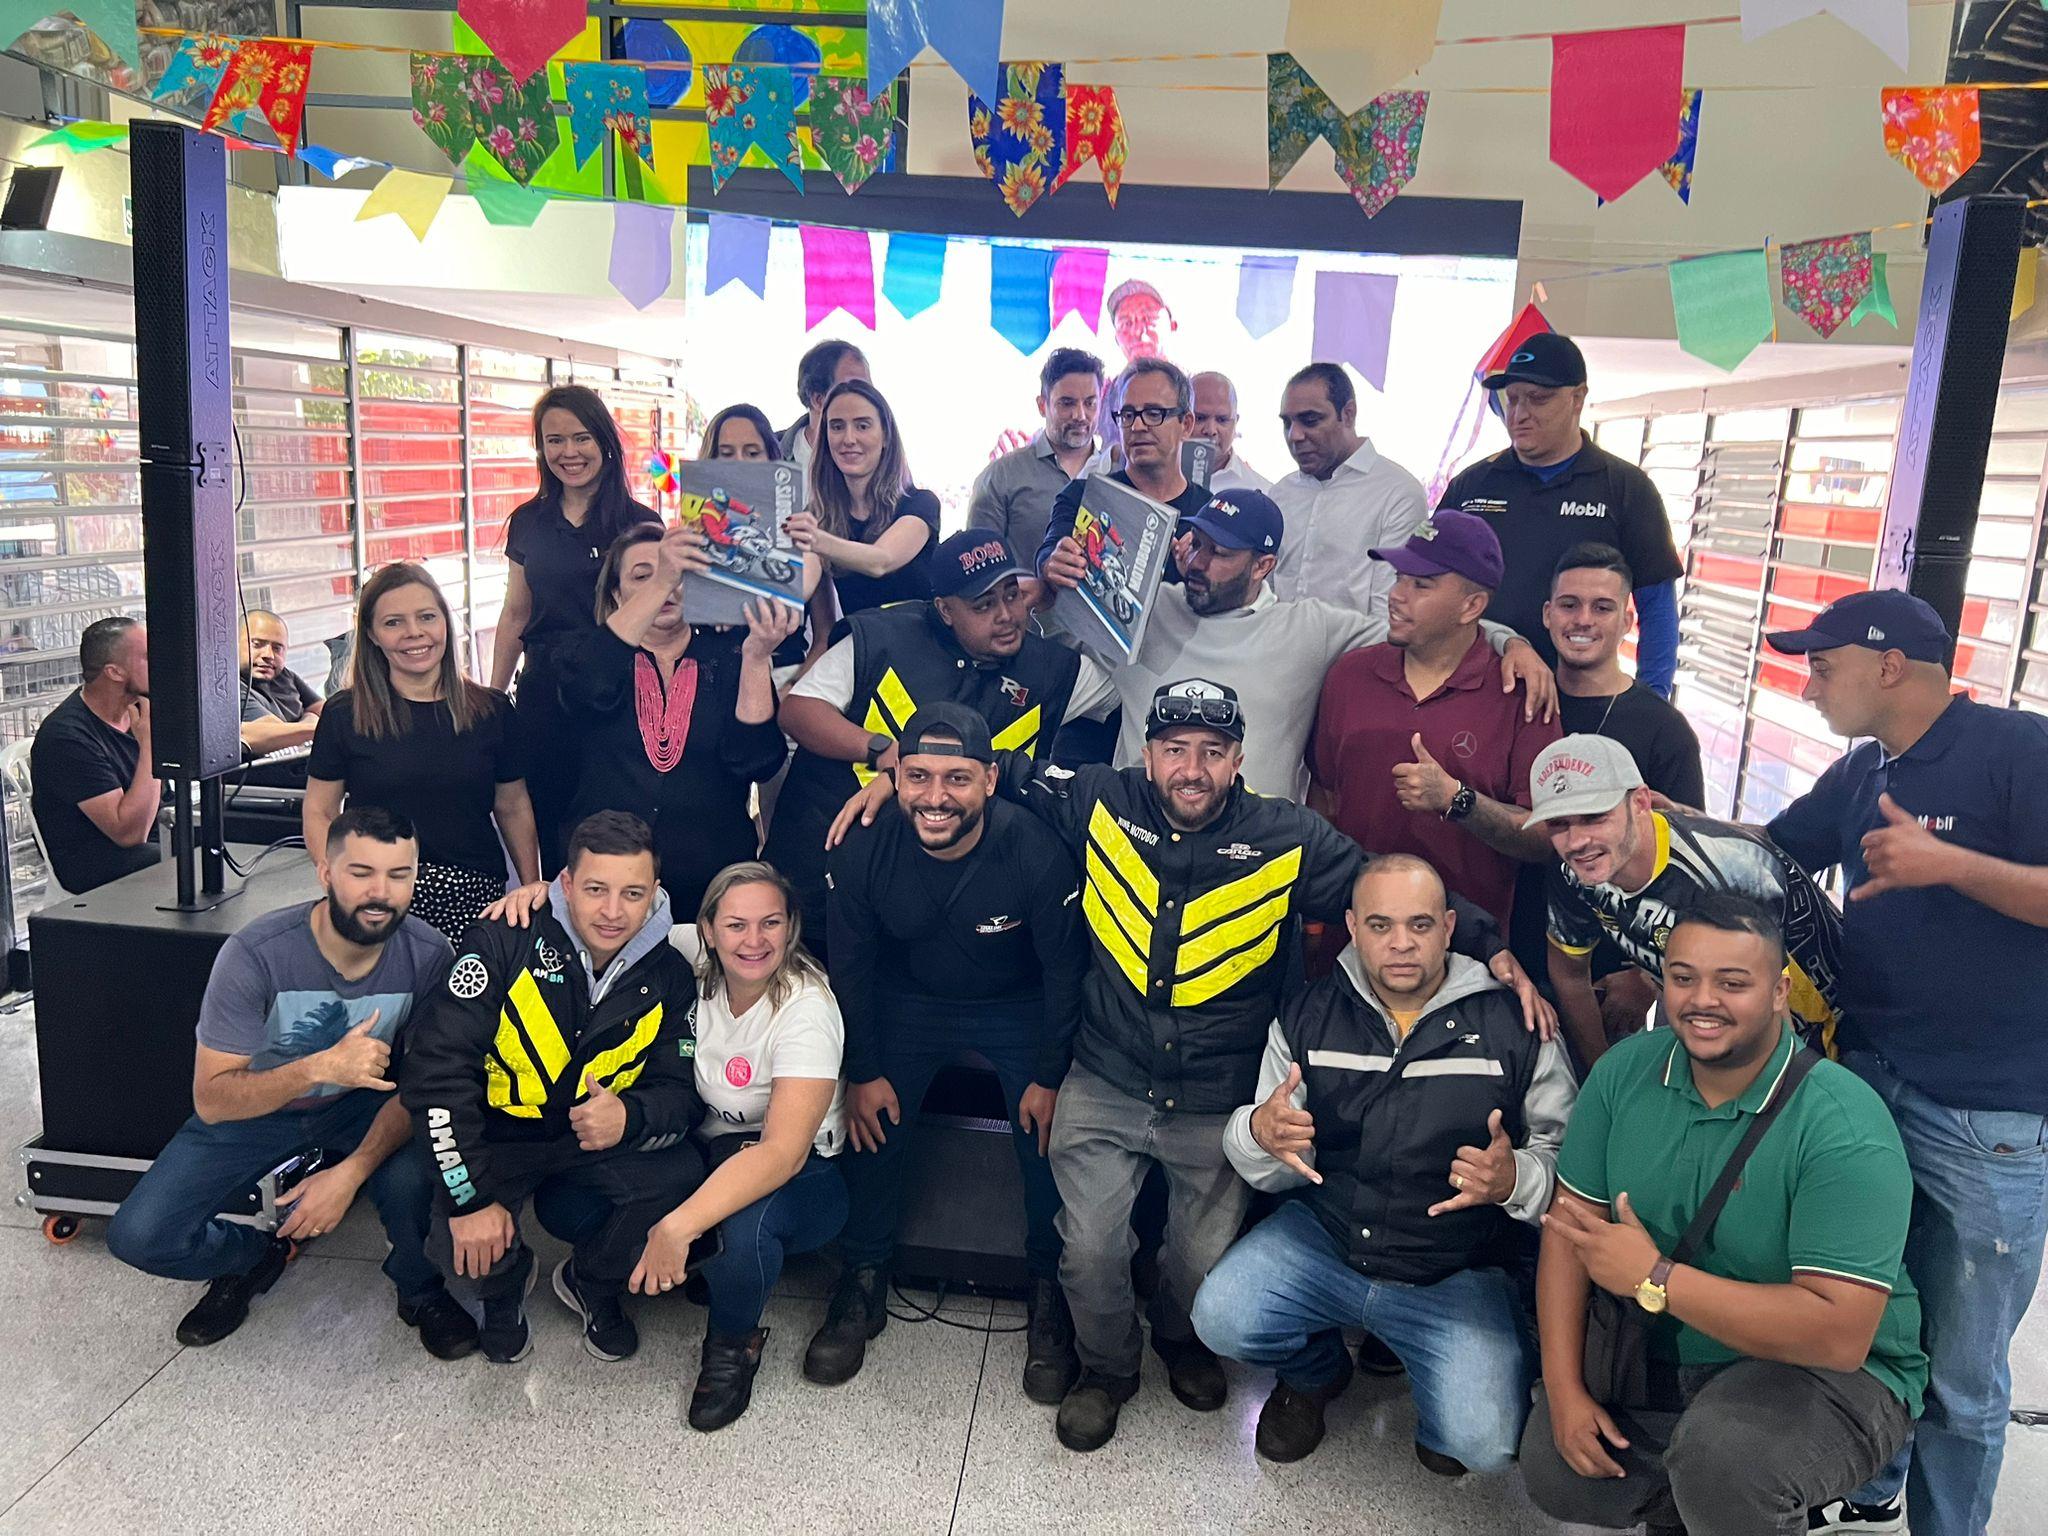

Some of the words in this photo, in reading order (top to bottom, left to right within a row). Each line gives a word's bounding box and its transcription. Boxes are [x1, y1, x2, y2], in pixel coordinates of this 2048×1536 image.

[200, 210, 220, 390] ATTACK
[1906, 282, 1944, 471] ATTACK
[1559, 500, 1607, 518] Mobil
[958, 540, 1006, 572] BOSS
[210, 538, 229, 701] ATTACK
[1129, 823, 1160, 847] MOTOBOY
[1917, 814, 1954, 831] Mobil
